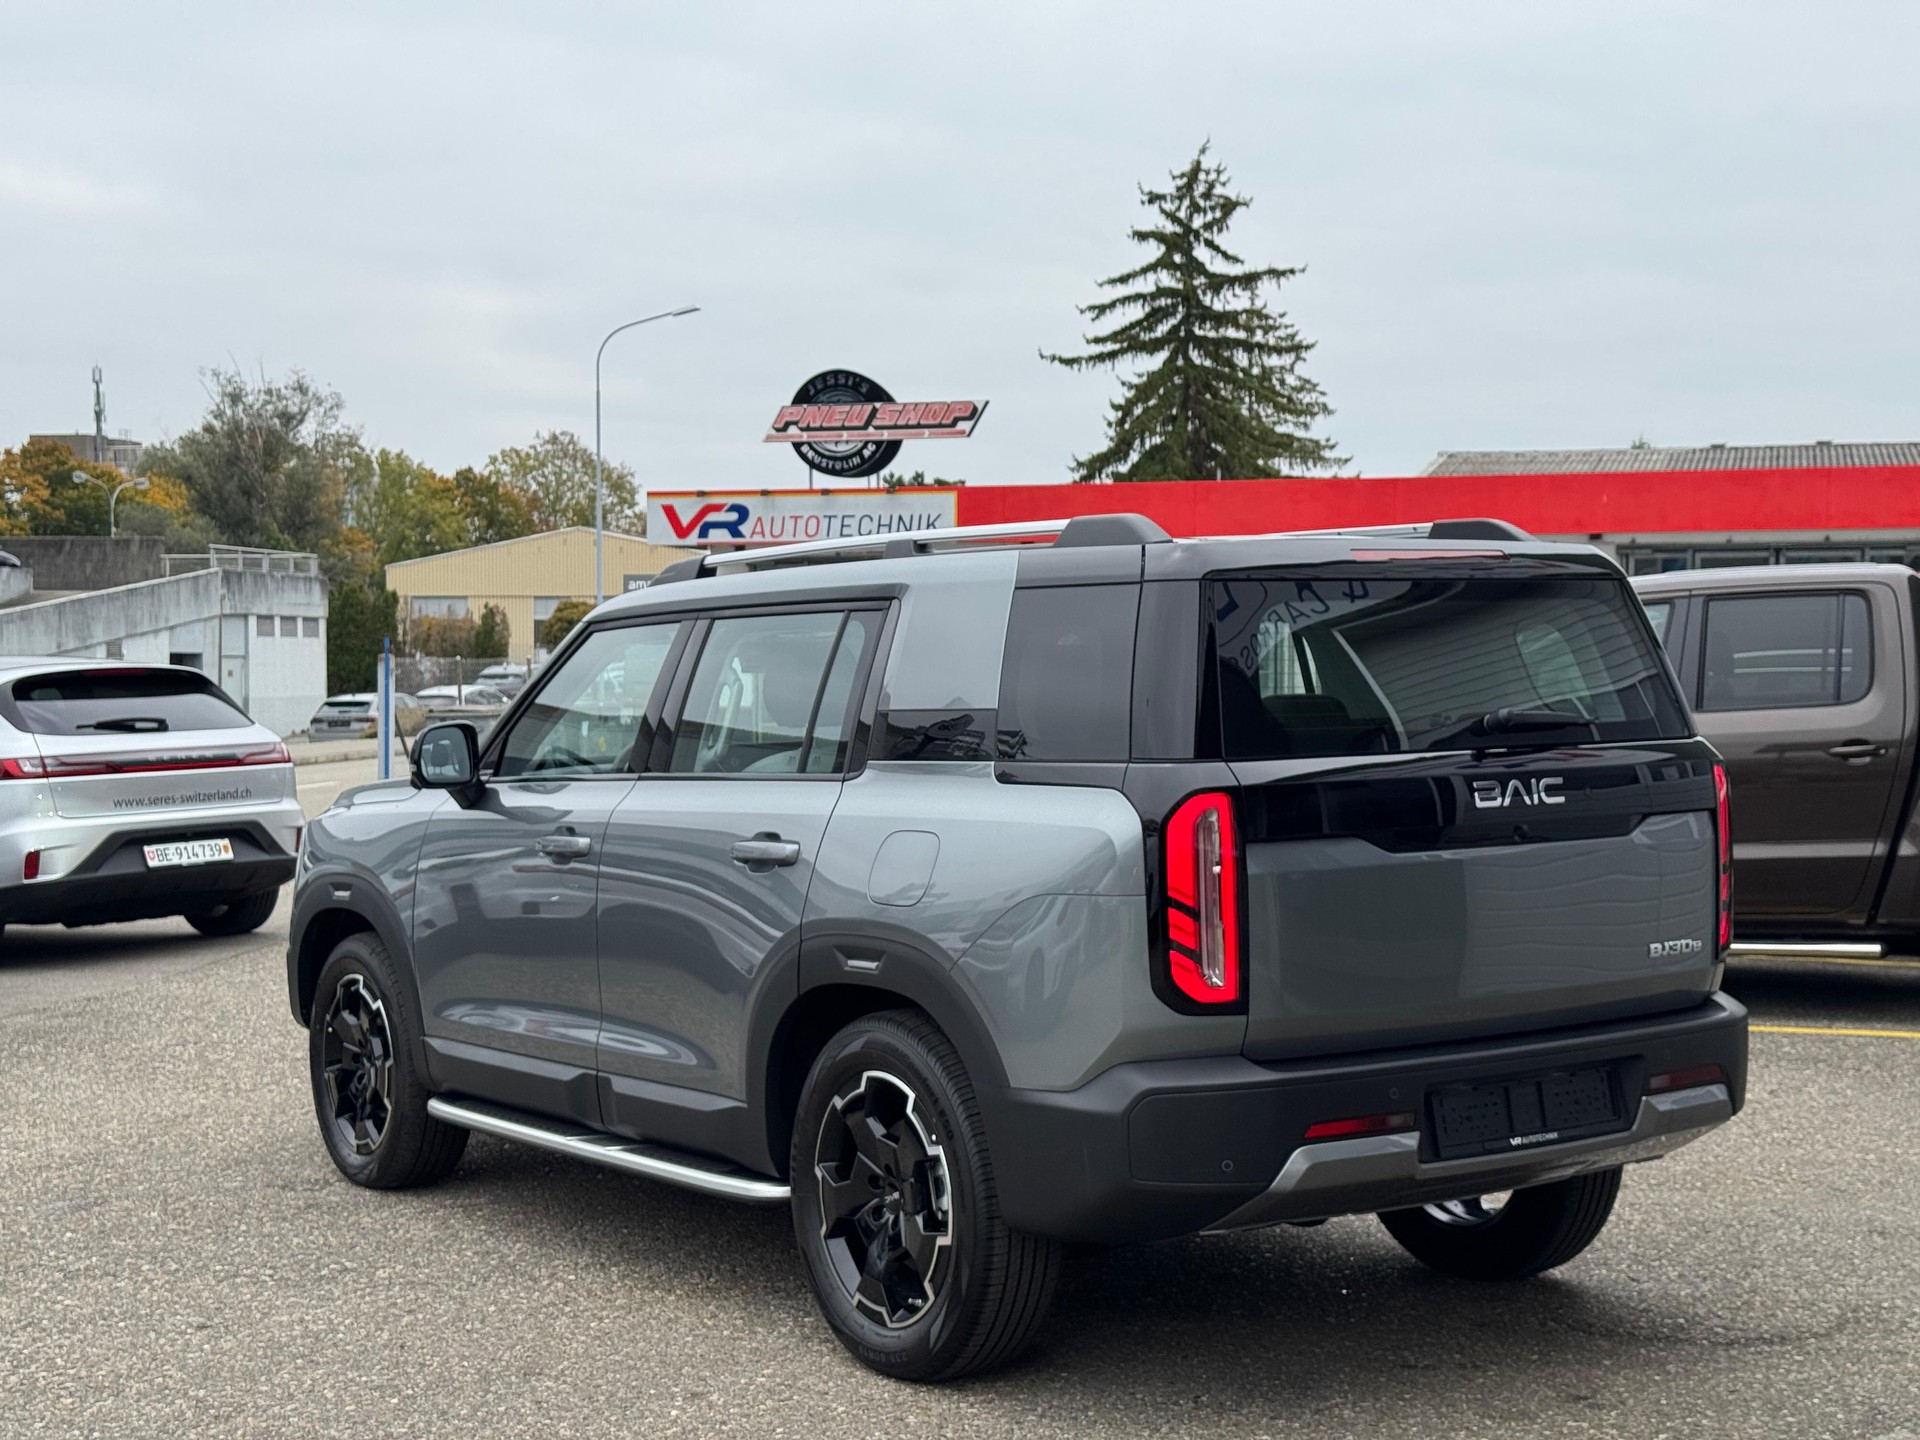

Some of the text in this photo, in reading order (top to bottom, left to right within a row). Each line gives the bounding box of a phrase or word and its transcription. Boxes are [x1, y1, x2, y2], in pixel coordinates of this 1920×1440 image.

[807, 372, 869, 396] JESSI'S
[772, 401, 979, 431] PNEU SHOP
[800, 442, 877, 470] BRUSTOLIN AG
[661, 503, 943, 540] VR AUTOTECHNIK
[113, 788, 252, 809] www.seres-switzerland.ch
[1473, 777, 1565, 808] BAIC
